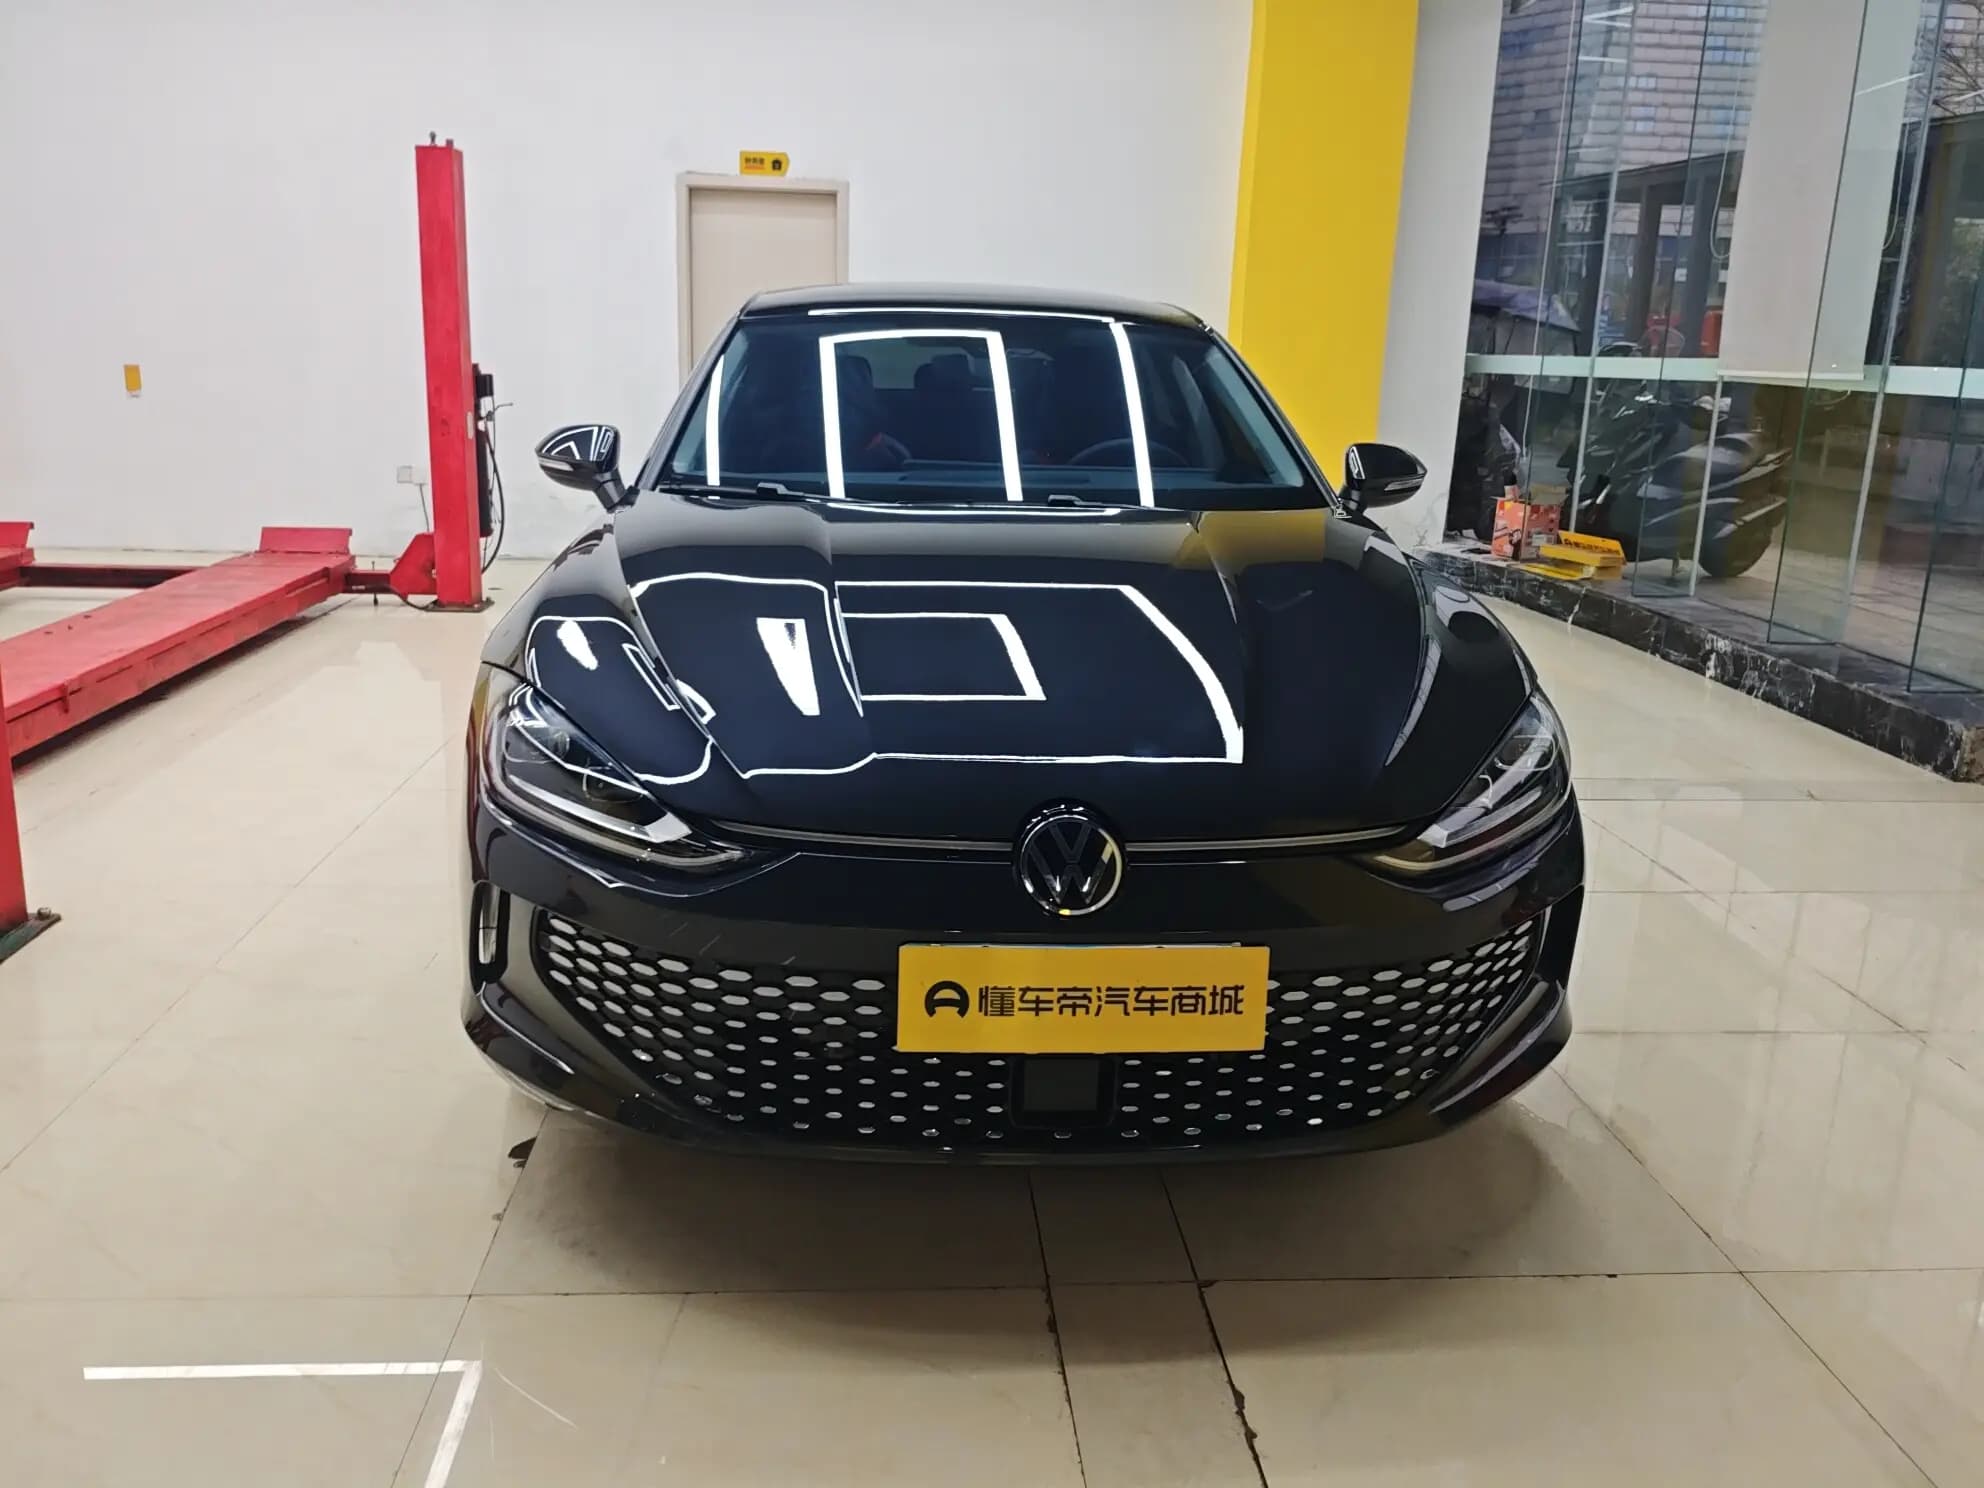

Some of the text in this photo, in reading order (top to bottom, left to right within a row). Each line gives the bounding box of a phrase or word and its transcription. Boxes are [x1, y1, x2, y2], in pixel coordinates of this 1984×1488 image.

[977, 984, 1246, 1017] 懂车帝汽车商城
